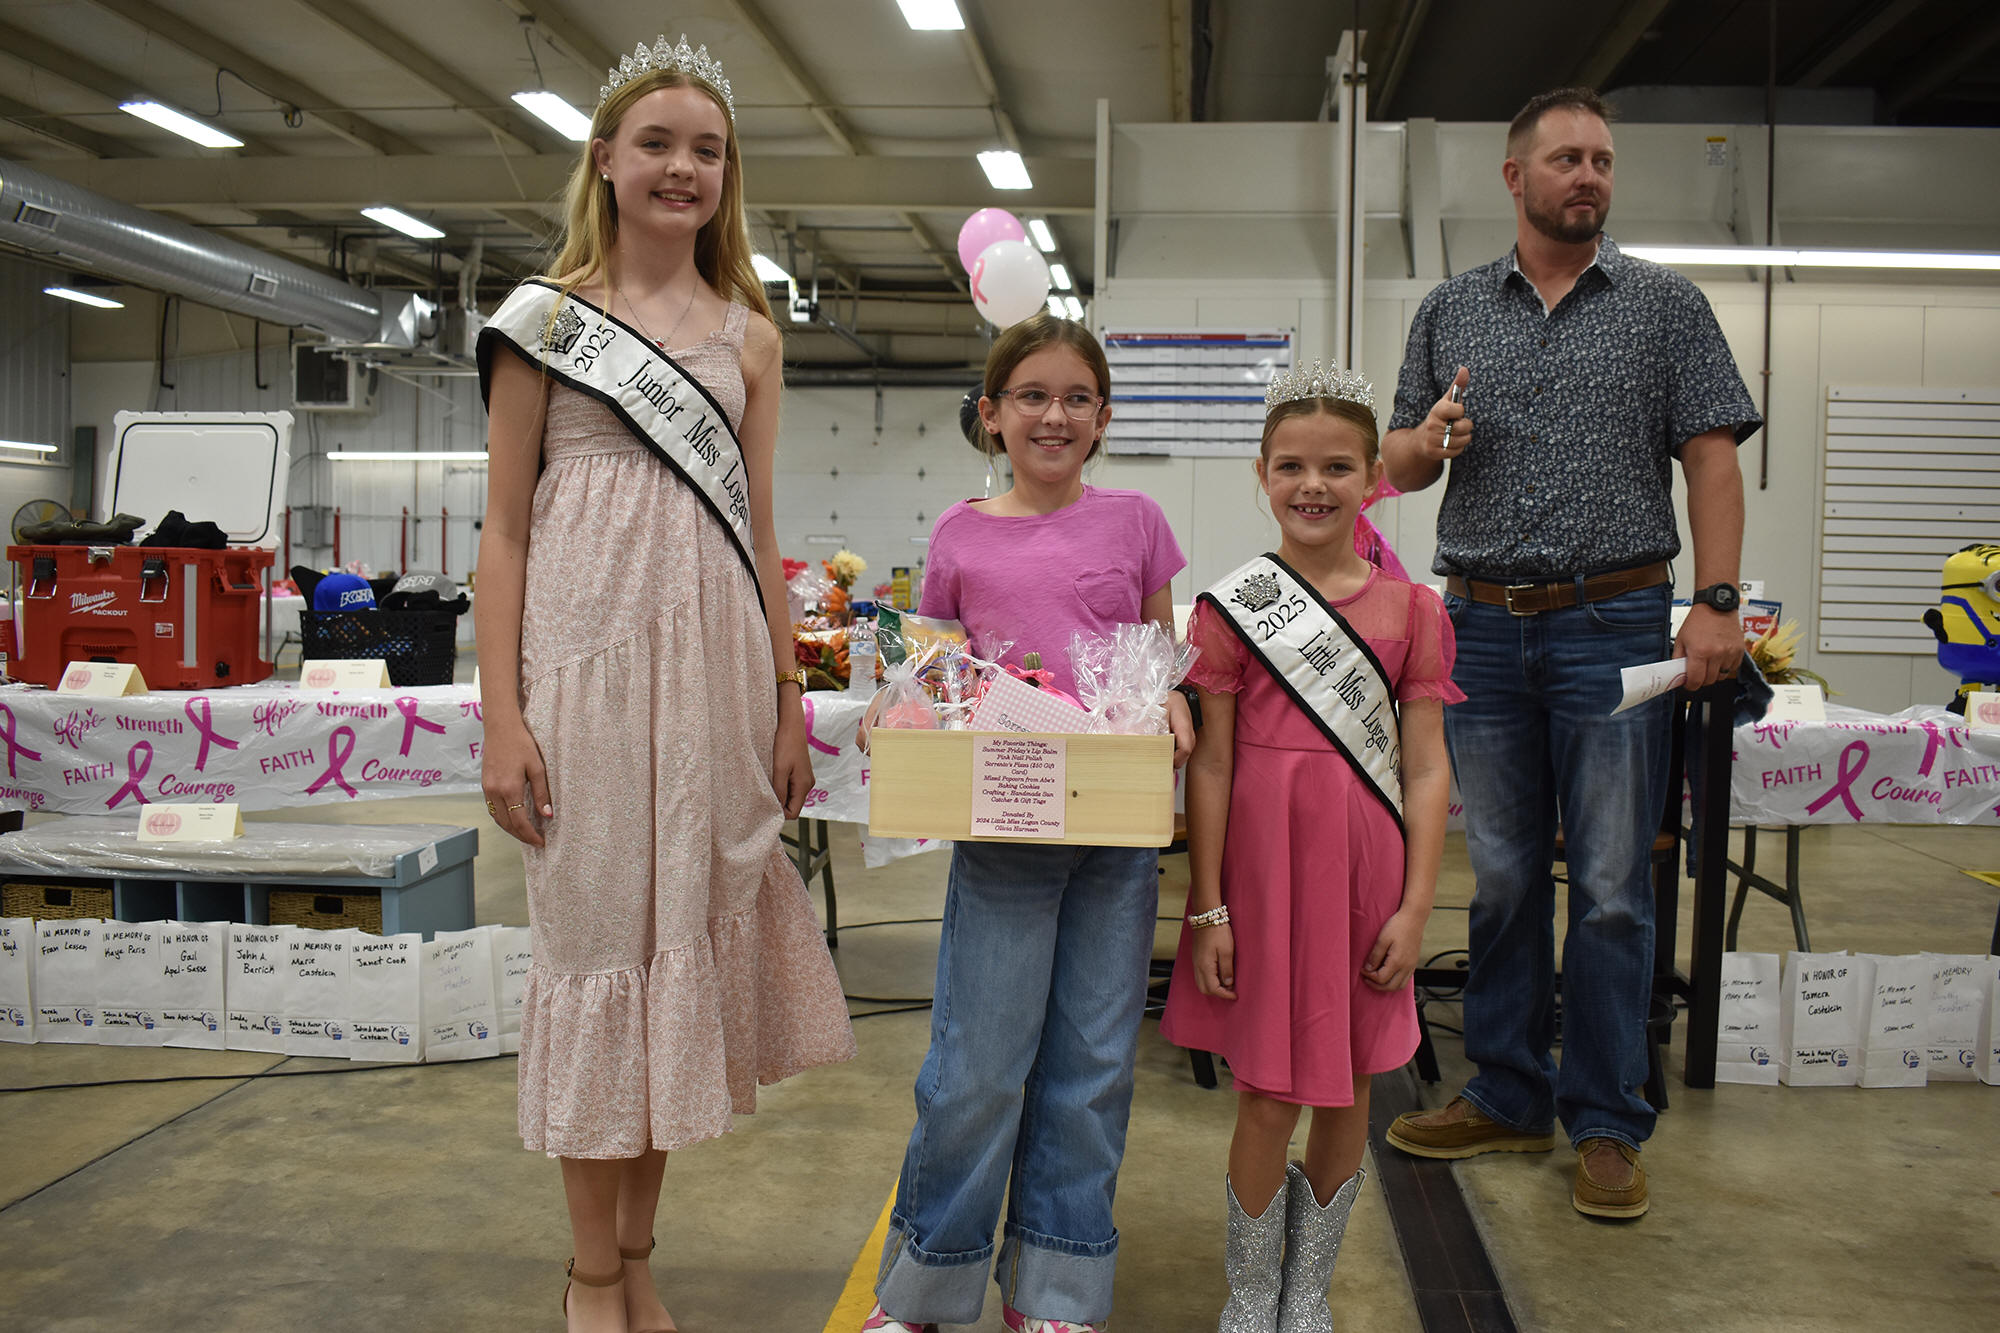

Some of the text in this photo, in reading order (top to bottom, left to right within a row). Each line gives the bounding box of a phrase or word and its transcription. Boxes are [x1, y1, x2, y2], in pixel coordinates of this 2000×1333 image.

[574, 323, 617, 373] 2025
[618, 359, 684, 422] Junior
[683, 413, 721, 467] Miss
[69, 590, 116, 608] Milwaukee
[1257, 594, 1307, 640] 2025
[1298, 630, 1341, 676] Little
[1332, 667, 1366, 711] Miss
[1361, 701, 1389, 753] Logan
[253, 700, 388, 737] Hope Strength
[54, 708, 183, 749] Hope Strength
[259, 748, 316, 774] FAITH
[63, 762, 114, 786] FAITH
[361, 758, 443, 788] Courage
[1761, 763, 1822, 789] FAITH
[158, 773, 236, 804] Courage
[43, 930, 51, 938] IN
[54, 928, 81, 936] MEMORY
[103, 932, 151, 942] IN MEMORY OF
[163, 934, 208, 944] IN HONOR OF
[233, 933, 279, 942] IN HONOR OF
[303, 942, 331, 951] MEMORY
[334, 943, 342, 951] OF
[363, 943, 393, 951] MEMORY
[181, 950, 197, 961] Gail
[291, 957, 315, 966] Marie
[1801, 968, 1847, 983] IN HONOR OF
[1942, 966, 1973, 978] MEMORY
